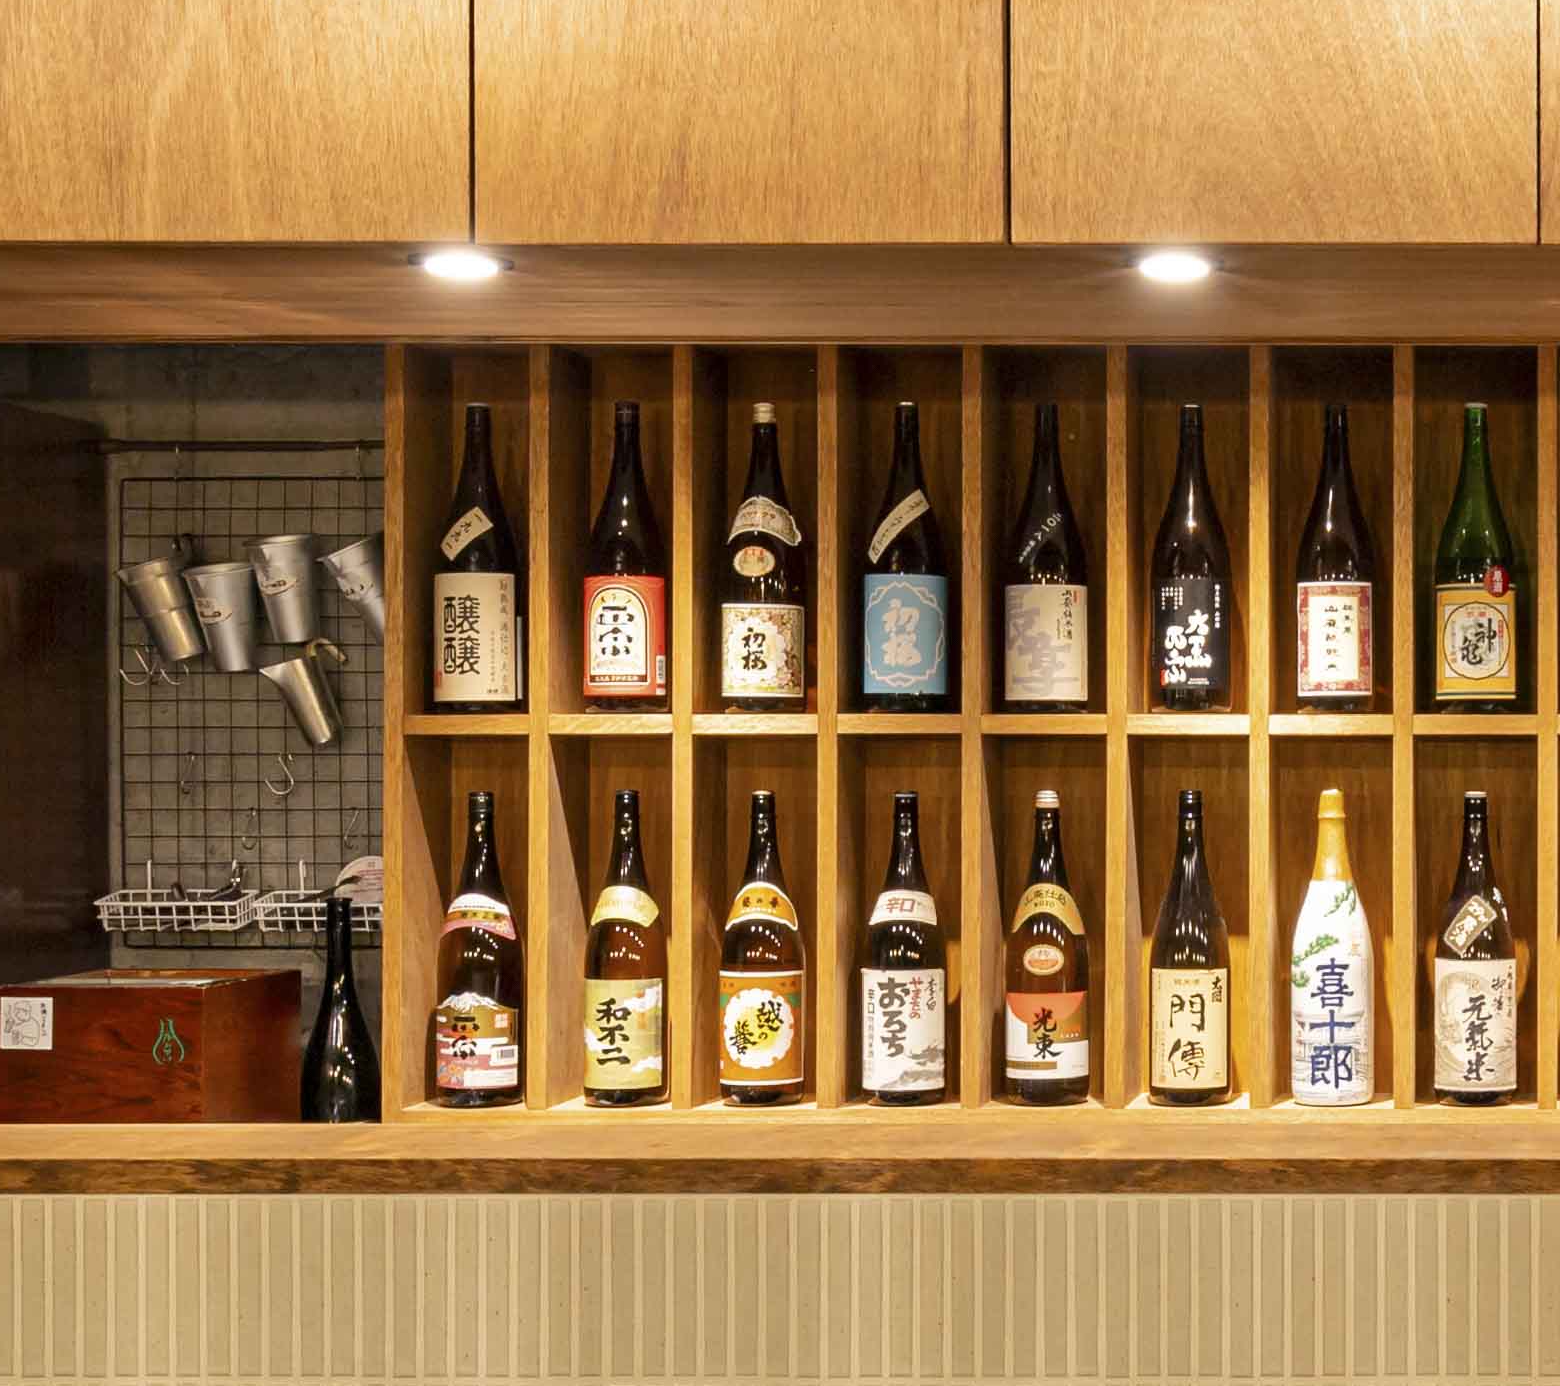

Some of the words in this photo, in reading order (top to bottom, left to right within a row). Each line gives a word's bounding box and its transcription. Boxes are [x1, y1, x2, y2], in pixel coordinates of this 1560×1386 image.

[595, 997, 632, 1067] 和不二
[877, 976, 910, 1058] おろち
[1309, 958, 1357, 1089] 喜十郎
